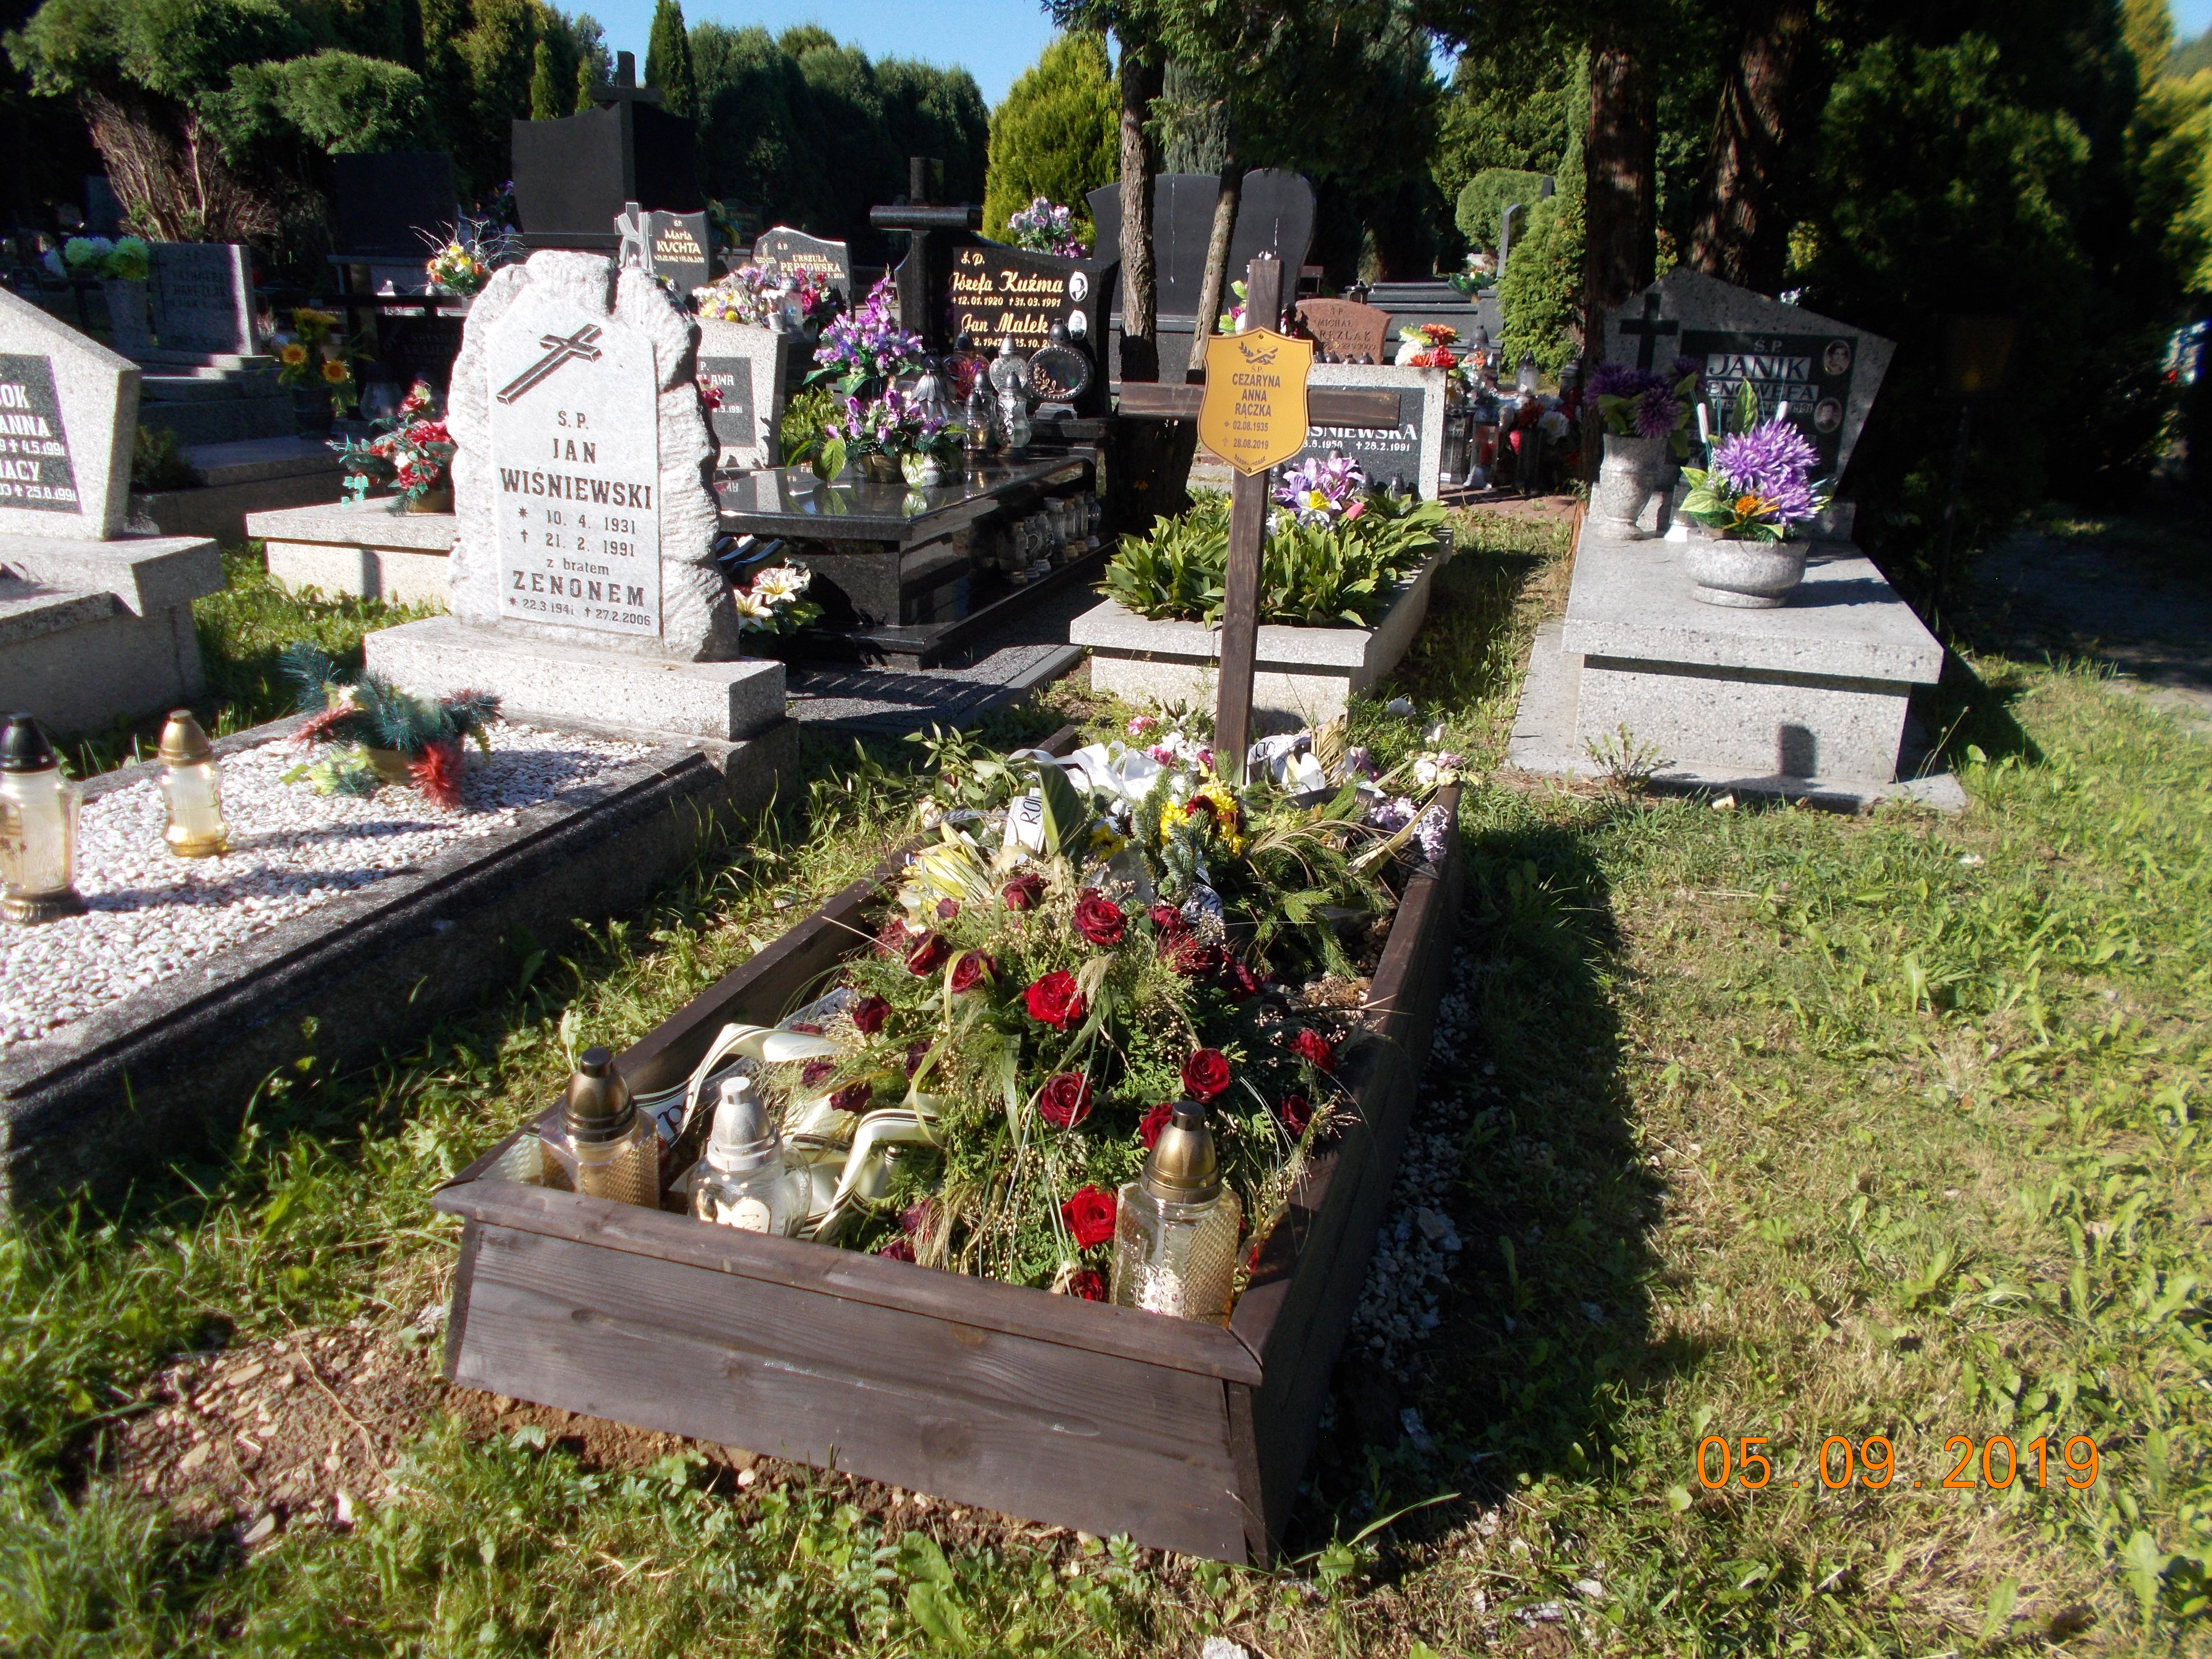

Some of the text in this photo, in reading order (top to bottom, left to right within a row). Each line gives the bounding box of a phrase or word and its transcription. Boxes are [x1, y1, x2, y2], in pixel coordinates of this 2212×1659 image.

[664, 229, 693, 240] Maria
[656, 240, 701, 254] KUCHTA
[793, 254, 828, 262] URSZULA
[949, 270, 1064, 295] Józefa Kuźma
[961, 312, 1049, 334] Jan Malek
[1708, 354, 1805, 380] JANIK
[1232, 373, 1281, 388] CEZARYNA
[0, 384, 30, 409] OK
[1241, 388, 1267, 402] ANNA
[1235, 402, 1272, 419] RĄCZKA
[1232, 421, 1269, 432] 02.08.1935
[553, 438, 597, 464] JAN
[1233, 438, 1269, 450] 28.08.2019
[1363, 441, 1410, 452] 28.2.1991
[25, 485, 77, 502] 25.8.1991
[500, 466, 652, 510] WIŚNIEWSKI
[604, 517, 636, 535] 1931
[603, 540, 635, 557] 1991
[546, 558, 610, 576] z bratem
[512, 569, 645, 607] ZENONEM
[596, 609, 651, 626] 27.2.2006
